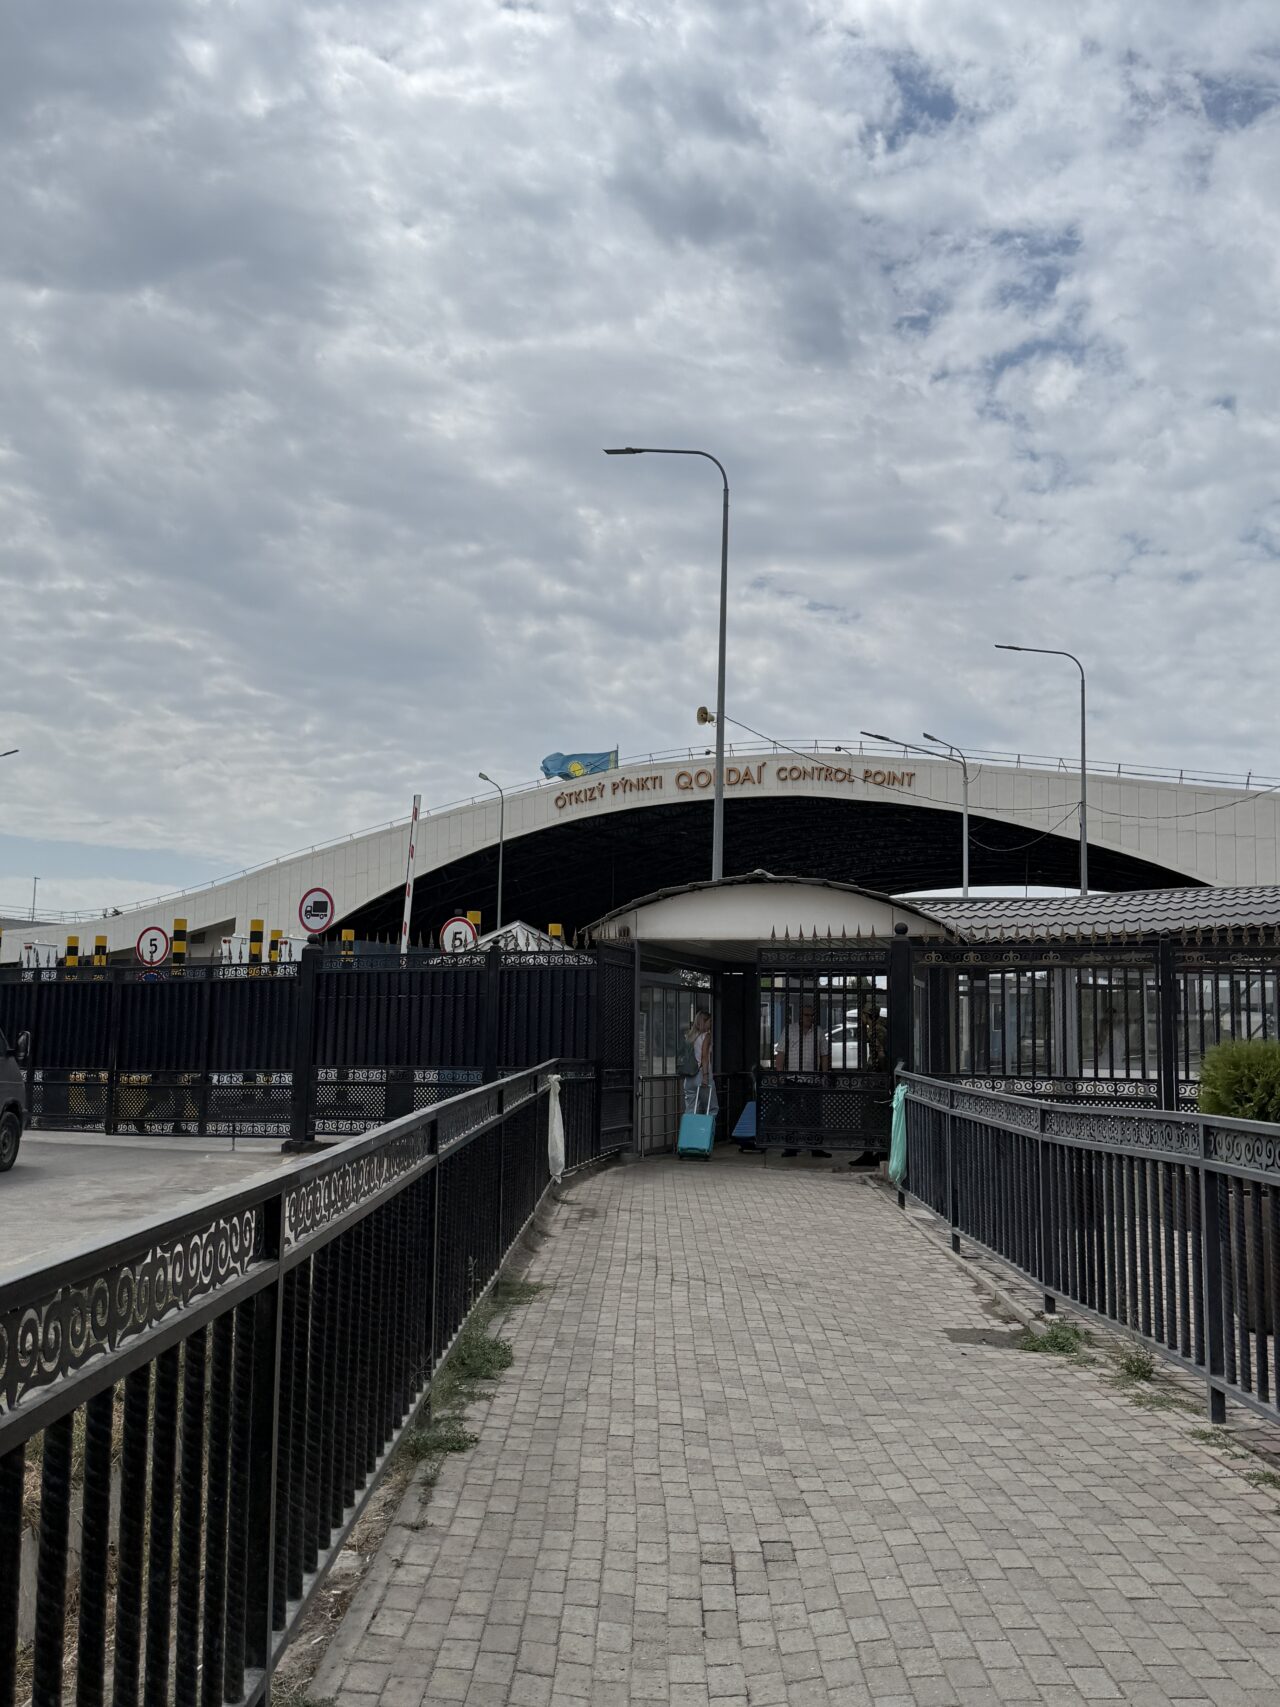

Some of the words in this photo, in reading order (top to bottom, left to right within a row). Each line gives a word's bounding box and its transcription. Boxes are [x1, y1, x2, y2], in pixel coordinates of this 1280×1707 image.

[776, 766, 855, 784] CONTROL
[863, 768, 916, 788] POINT
[149, 938, 158, 954] 5
[454, 931, 463, 947] 5
